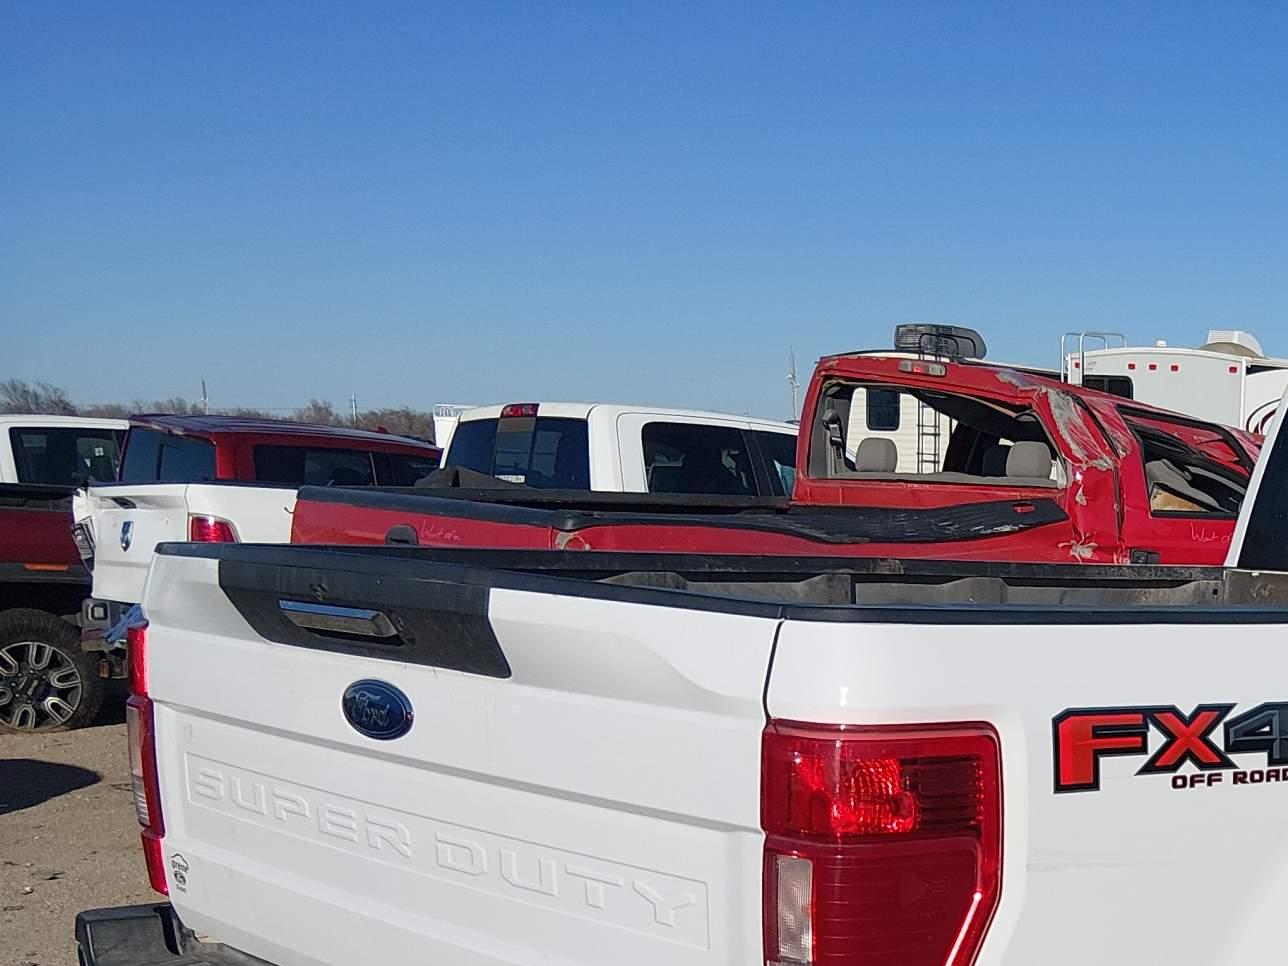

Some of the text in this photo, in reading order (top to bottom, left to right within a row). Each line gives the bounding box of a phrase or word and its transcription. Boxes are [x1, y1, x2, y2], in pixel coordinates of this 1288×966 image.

[1171, 772, 1223, 789] OFF
[193, 769, 696, 928] SUPER DUTY
